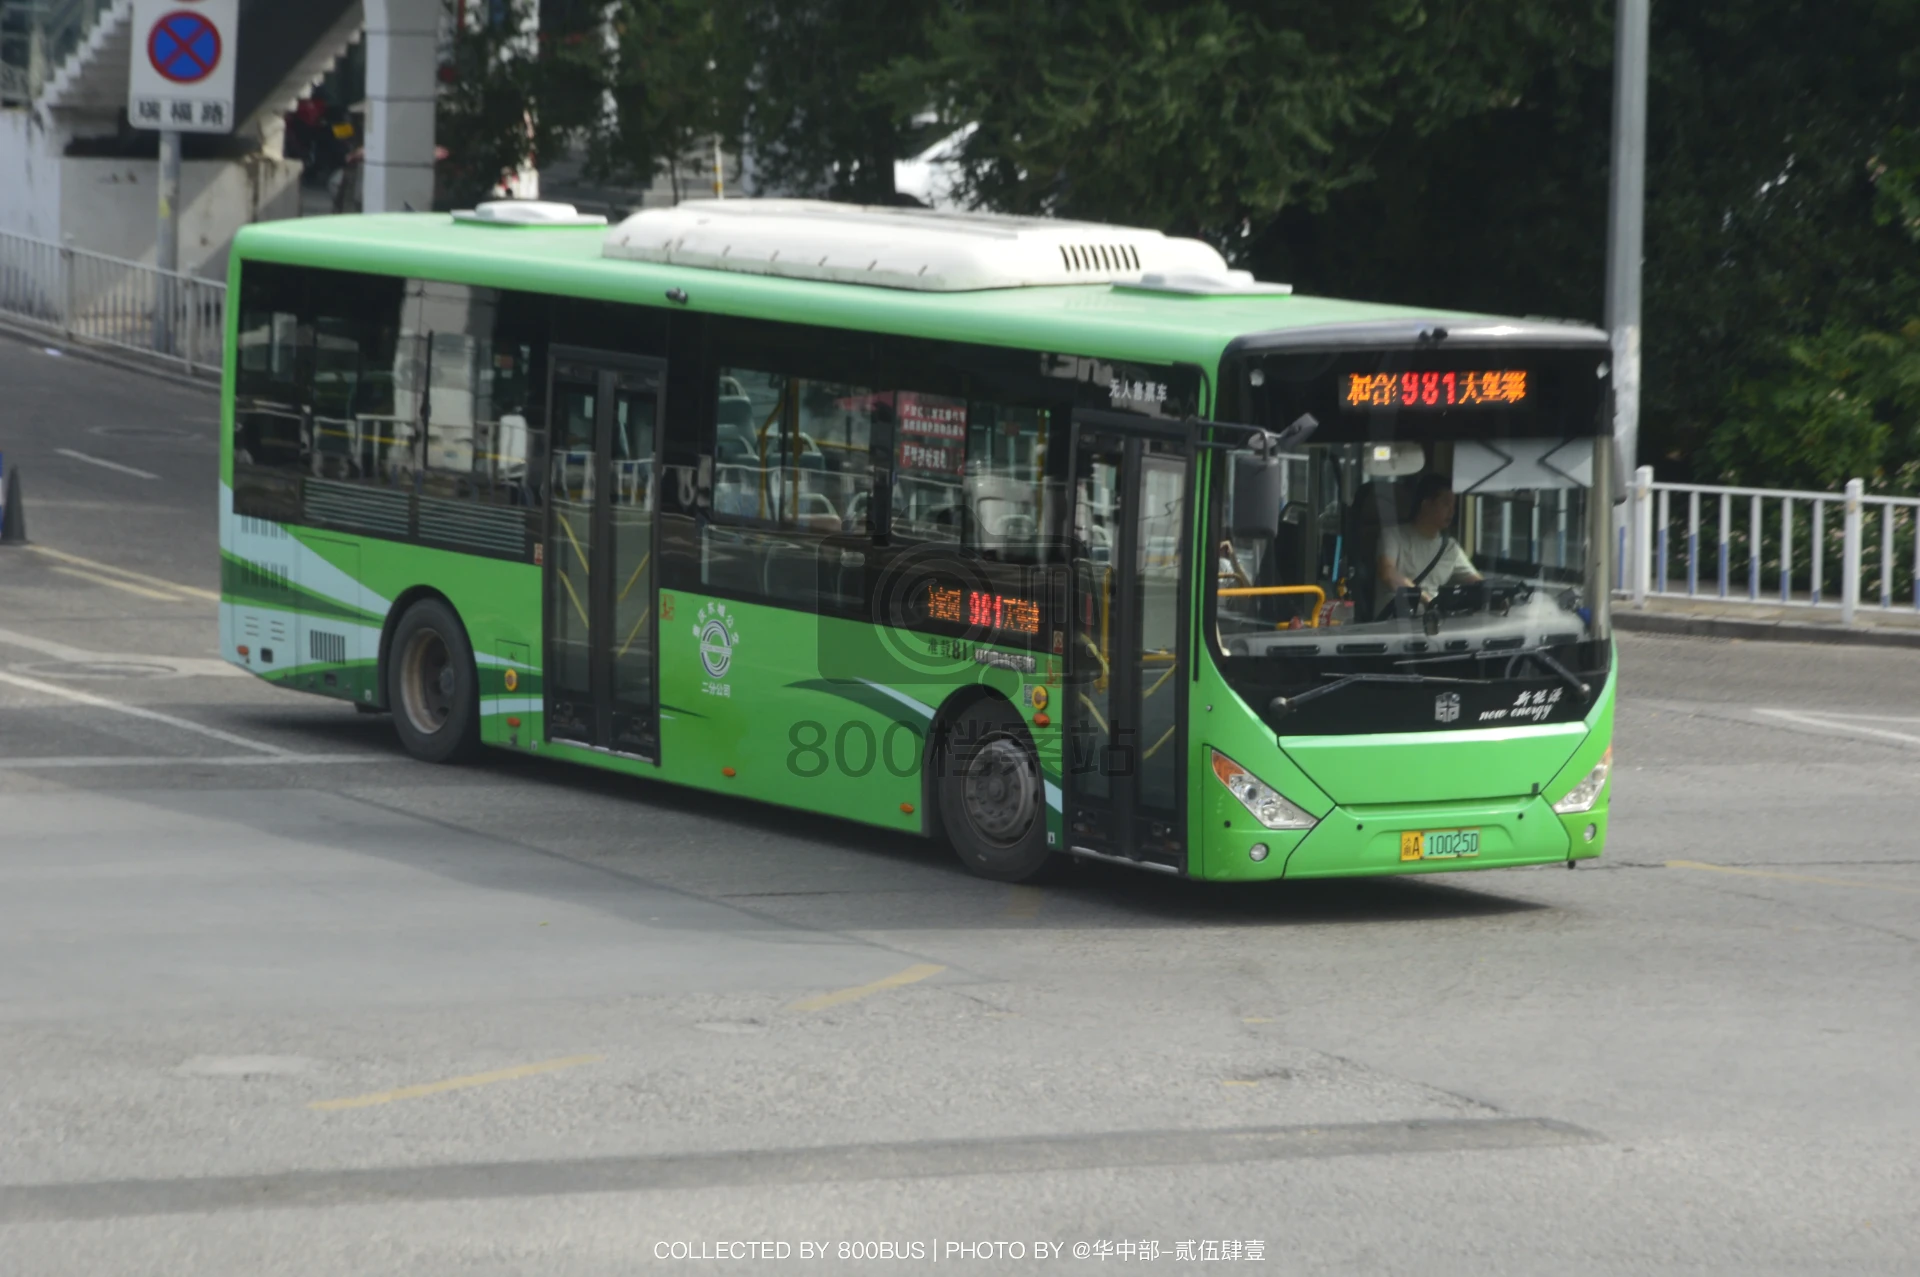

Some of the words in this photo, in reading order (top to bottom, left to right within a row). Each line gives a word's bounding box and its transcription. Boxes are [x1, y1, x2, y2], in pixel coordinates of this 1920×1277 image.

[1109, 379, 1168, 403] 无人售票车
[1347, 372, 1398, 406] 和合
[1401, 371, 1456, 406] 981
[969, 591, 1003, 629] 981
[701, 682, 731, 698] 二分公司
[1513, 686, 1564, 706] 新能源
[1479, 708, 1510, 721] new
[1510, 703, 1554, 722] energy
